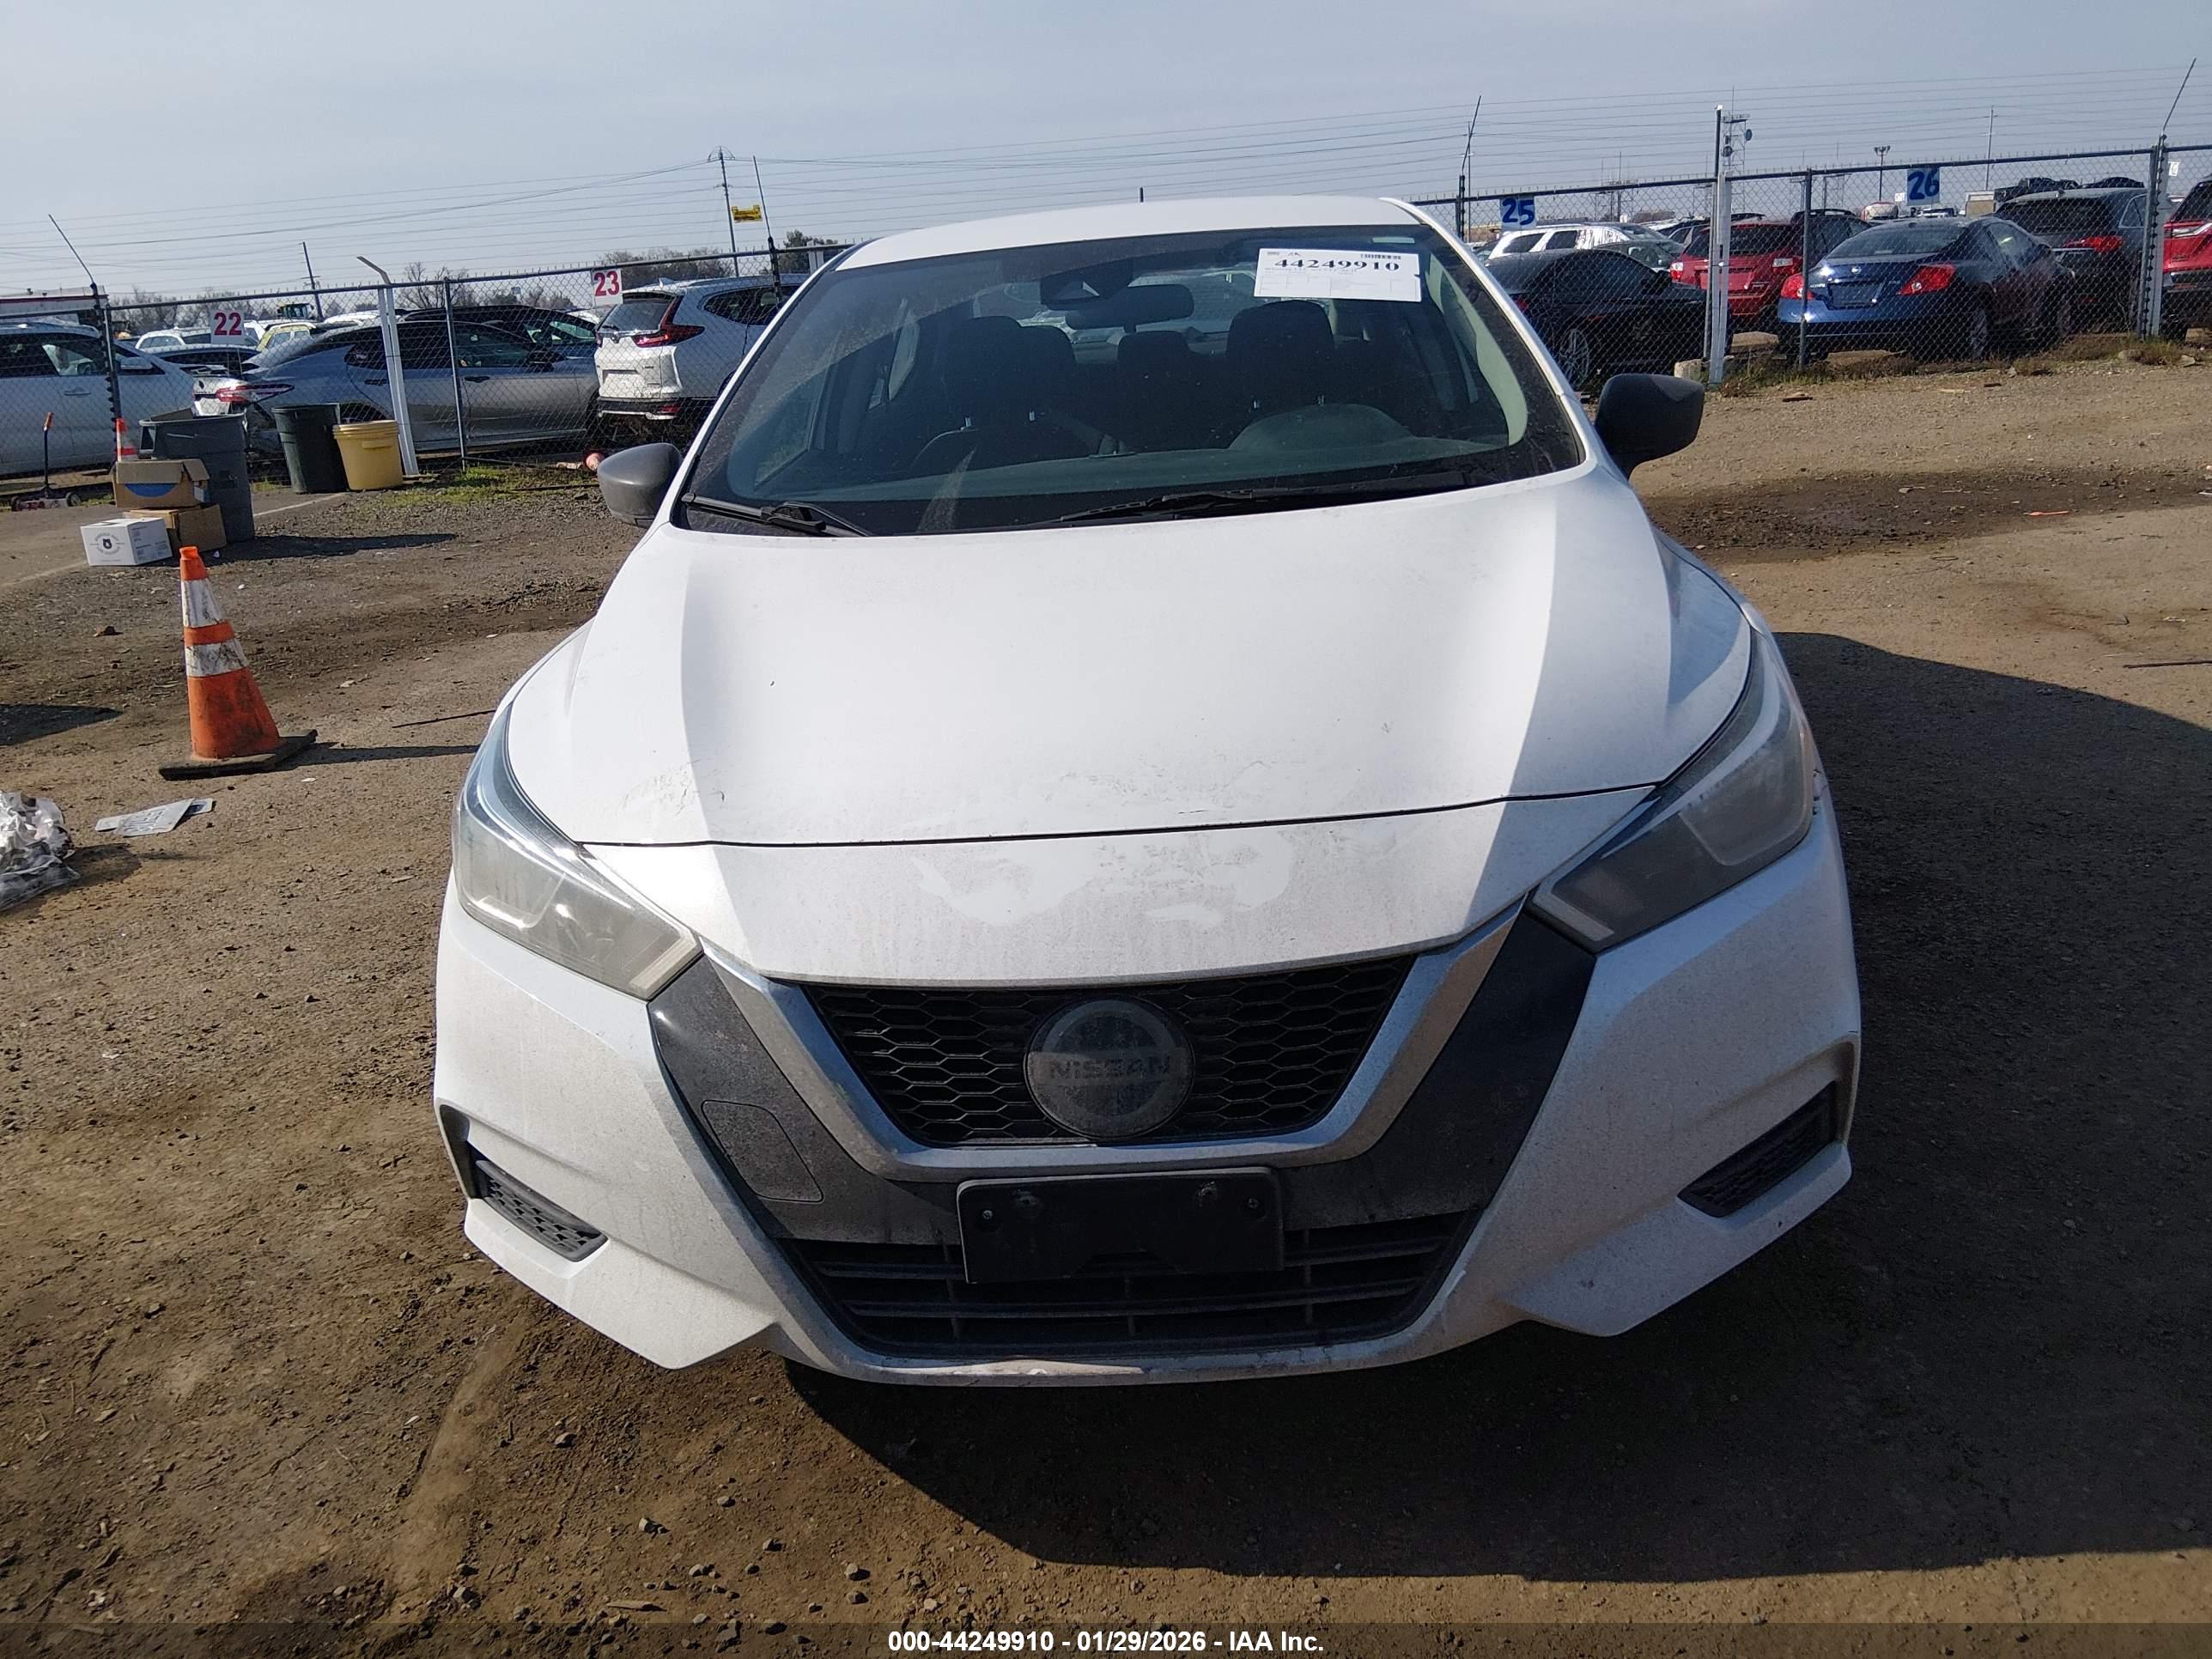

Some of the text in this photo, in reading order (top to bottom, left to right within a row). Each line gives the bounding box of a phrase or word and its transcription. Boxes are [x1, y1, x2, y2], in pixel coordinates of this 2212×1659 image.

[1907, 168, 1940, 200] 26
[1502, 198, 1535, 226] 25
[1274, 258, 1401, 271] 44249910
[593, 270, 620, 297] 23
[213, 312, 242, 336] 22
[1049, 1055, 1170, 1080] NISSAN
